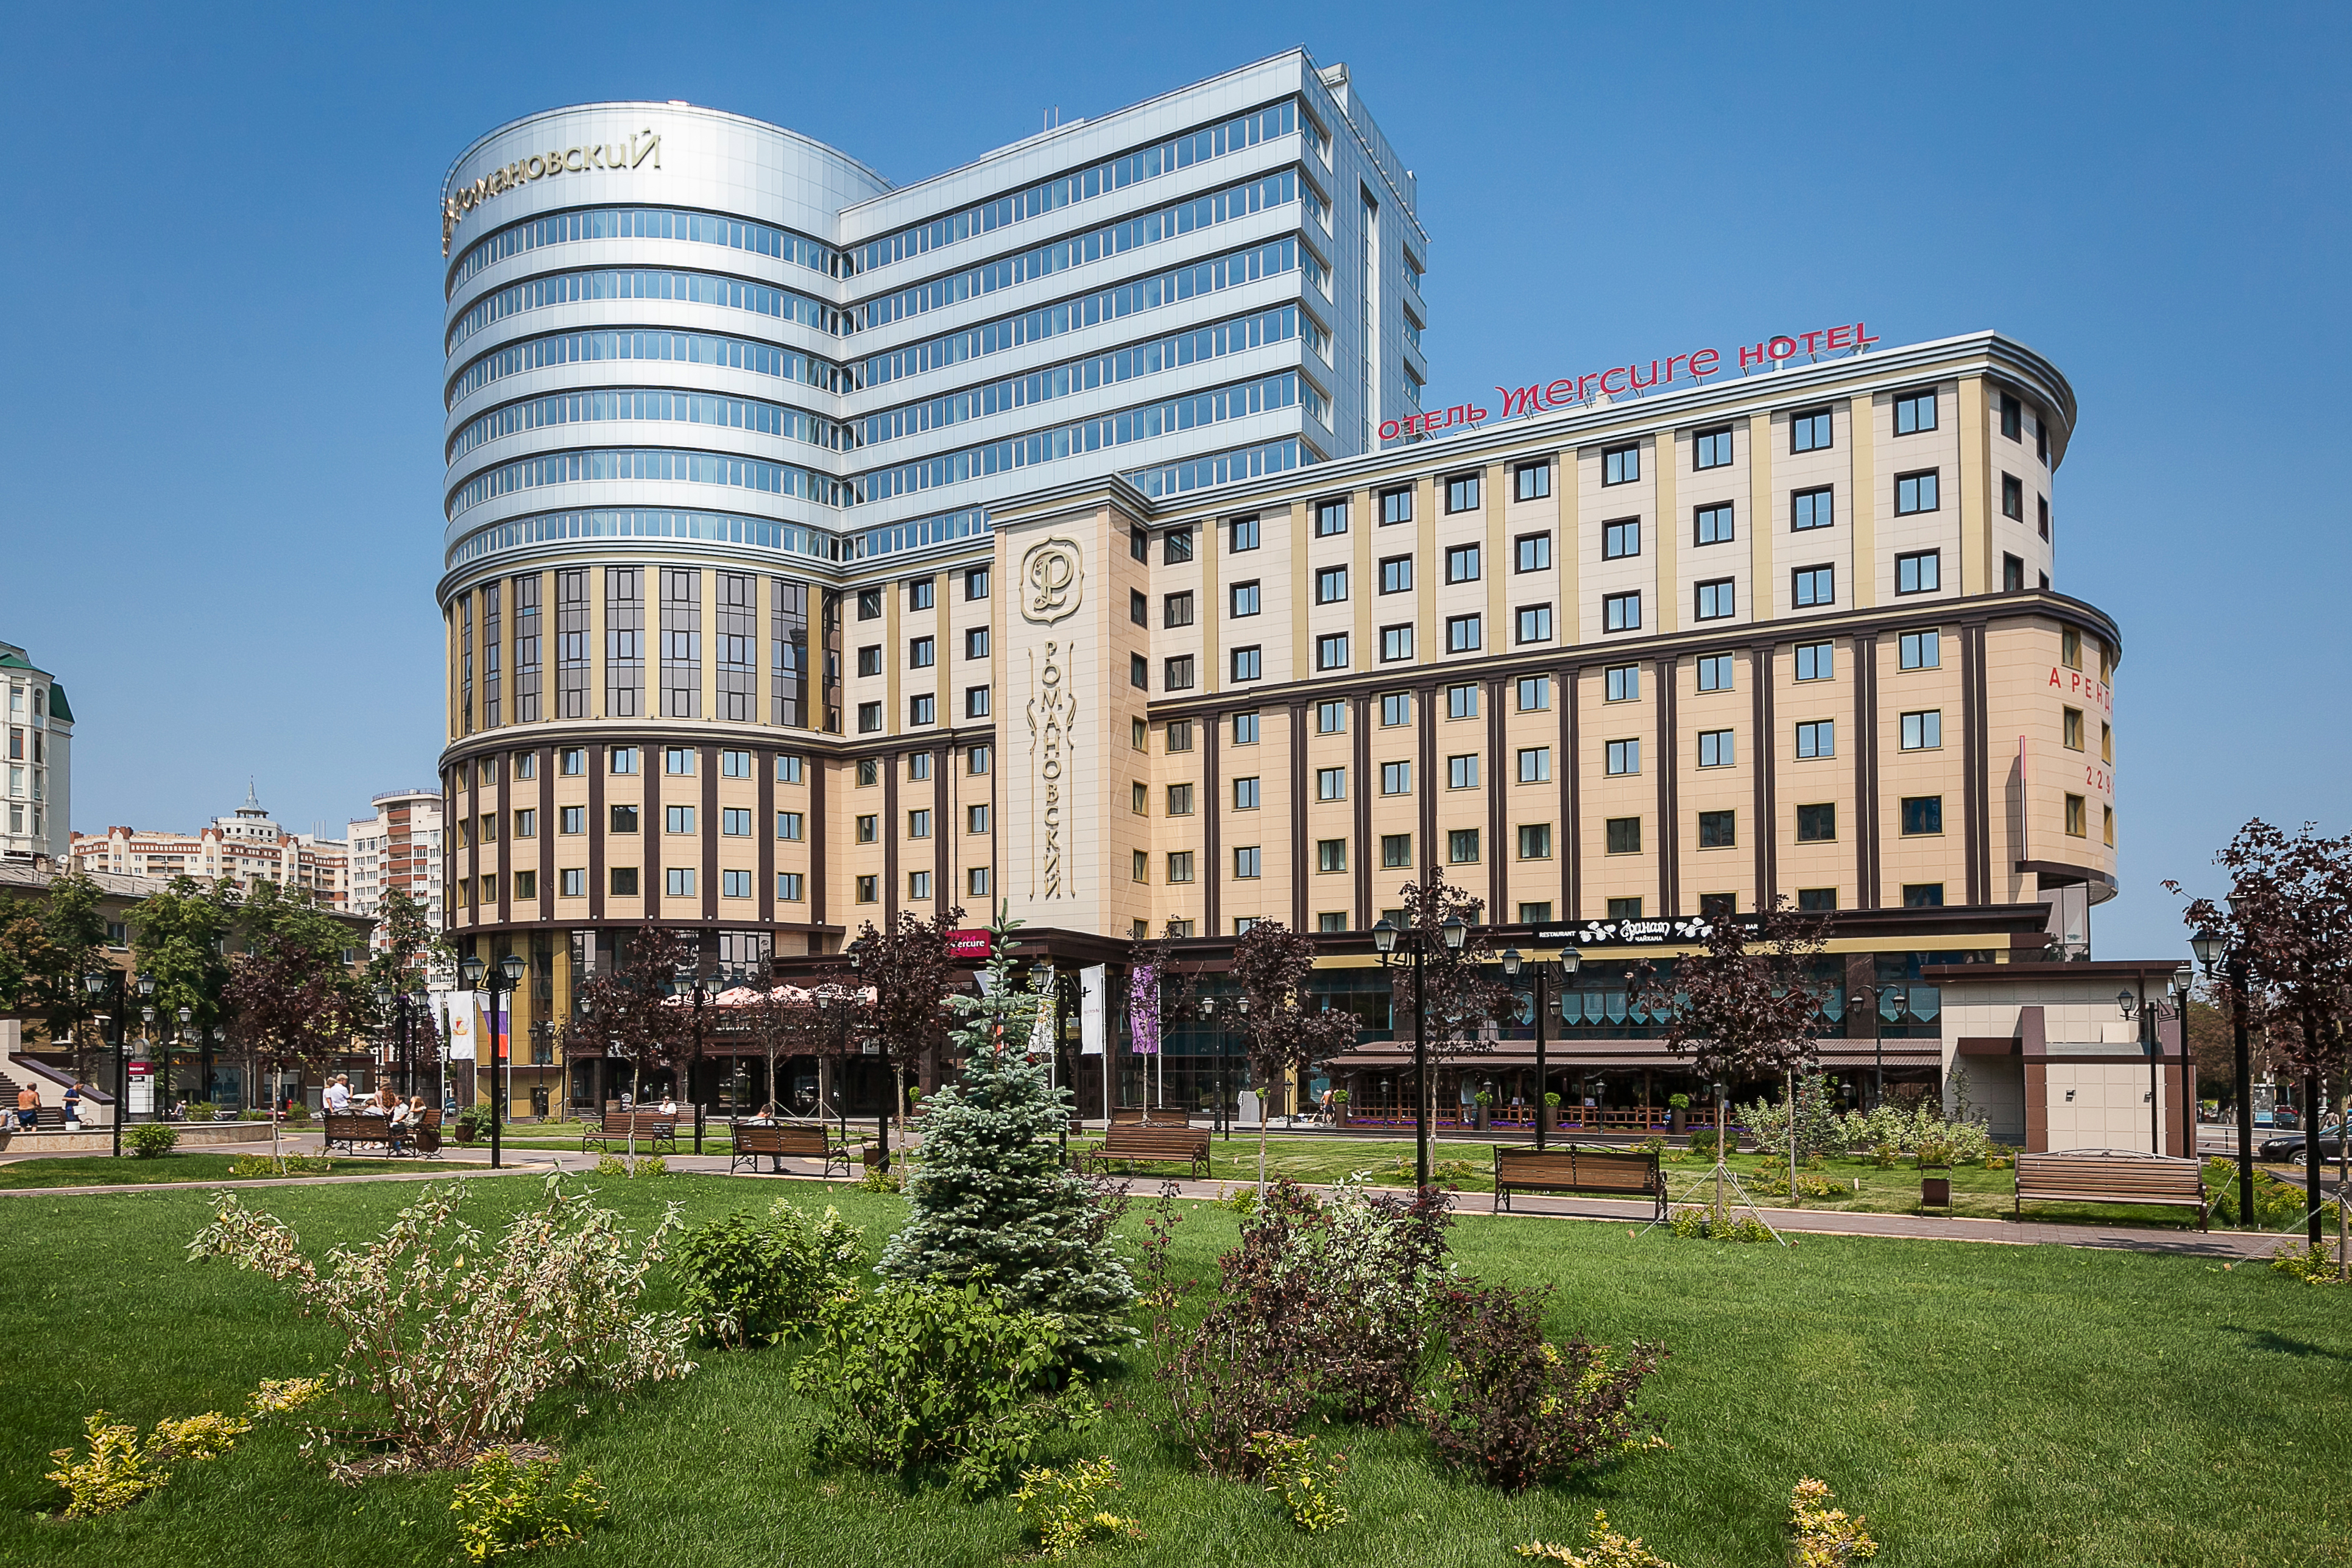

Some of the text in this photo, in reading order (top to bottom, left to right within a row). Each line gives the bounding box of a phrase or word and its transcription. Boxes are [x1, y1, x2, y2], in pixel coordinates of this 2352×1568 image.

[1379, 322, 1880, 440] ОТЕЛЬ Mercure HOTEL
[2049, 667, 2113, 716] АРЕНД
[1040, 640, 1064, 899] РОМАНОВСКИЙ
